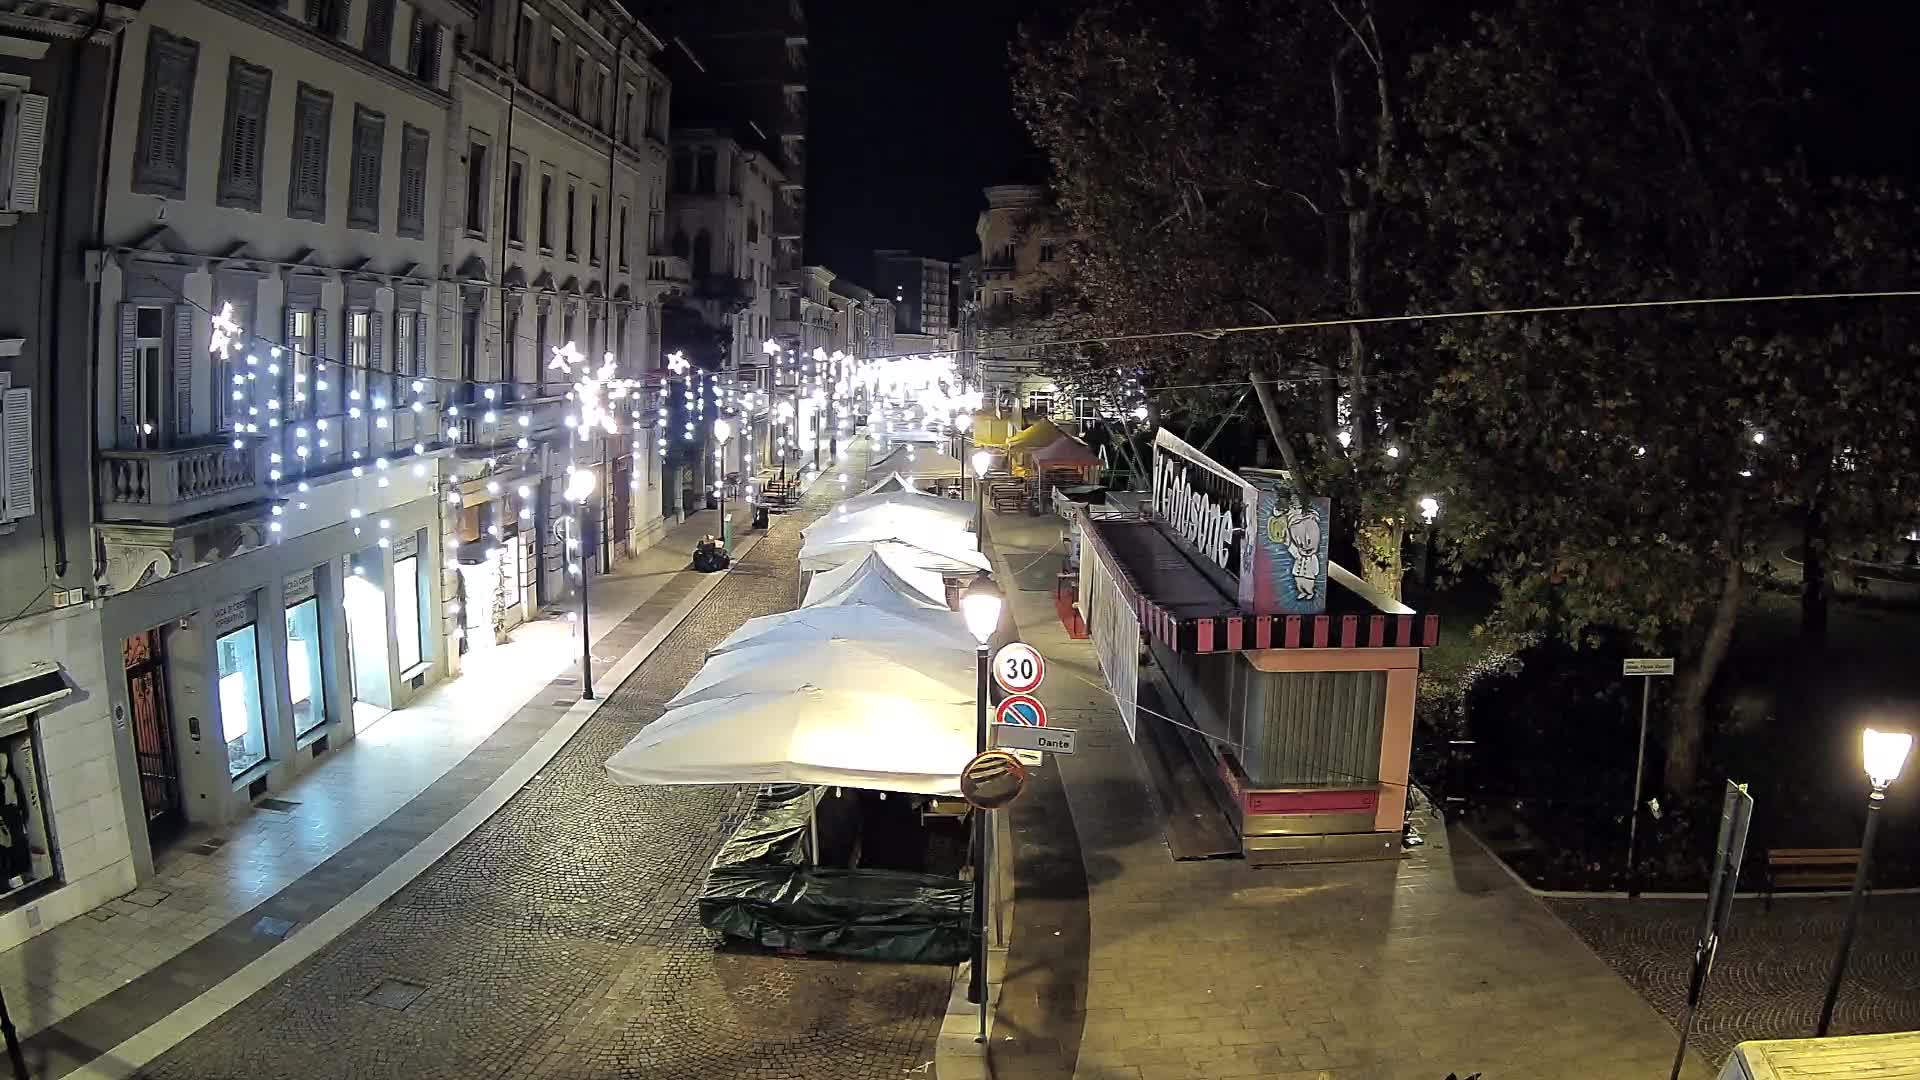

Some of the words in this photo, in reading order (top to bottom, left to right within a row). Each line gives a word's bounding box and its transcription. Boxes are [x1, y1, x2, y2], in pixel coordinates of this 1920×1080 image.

[1162, 458, 1233, 569] Golosone
[1006, 658, 1033, 679] 30
[1038, 737, 1070, 749] Dante
